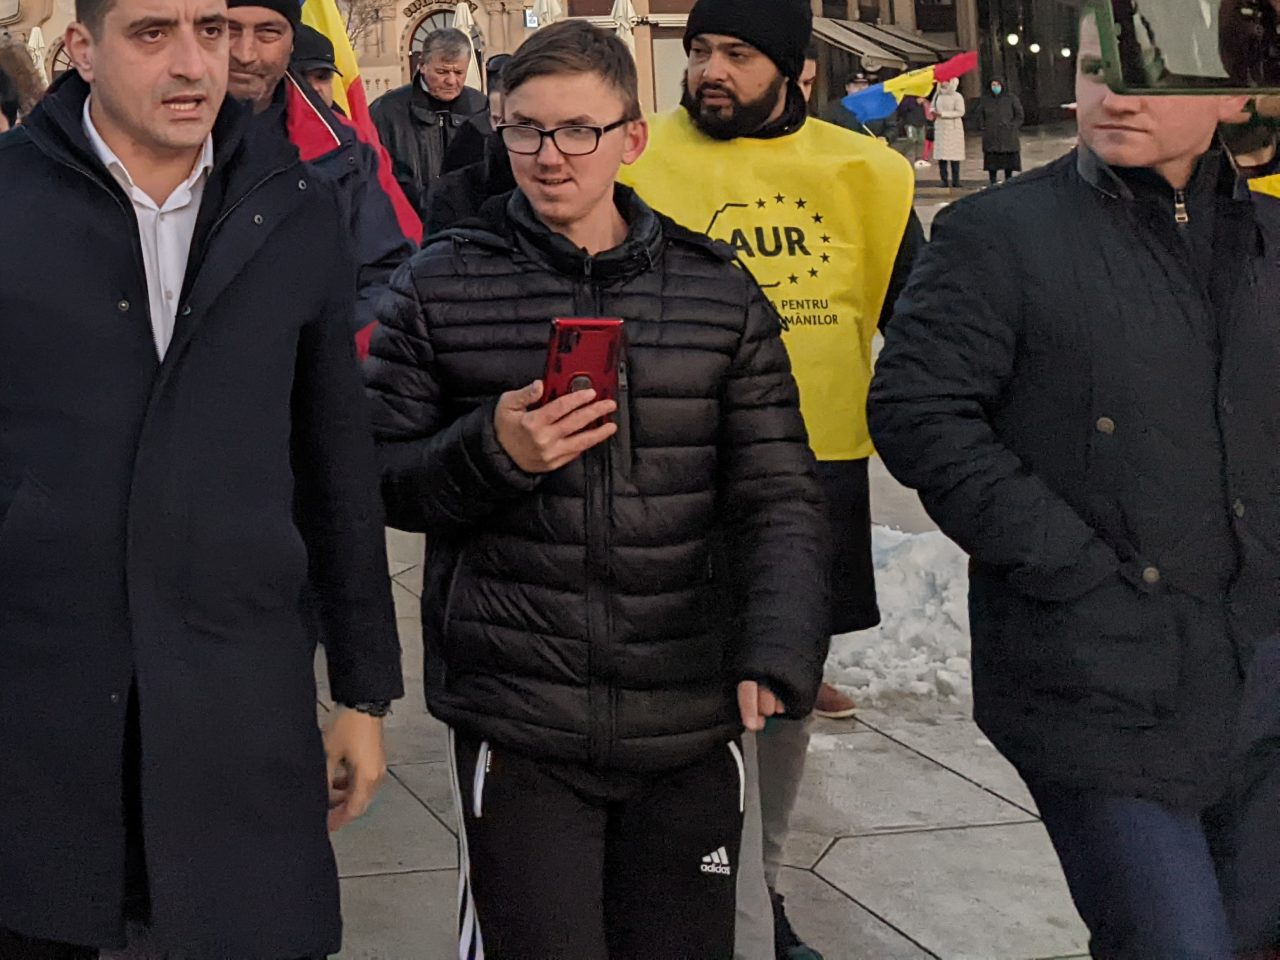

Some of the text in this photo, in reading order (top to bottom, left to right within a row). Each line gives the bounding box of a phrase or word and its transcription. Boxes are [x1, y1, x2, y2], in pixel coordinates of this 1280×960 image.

[730, 226, 811, 258] AUR
[781, 299, 829, 310] PENTRU
[784, 312, 839, 326] MÂNILOR
[700, 863, 731, 876] adidas
